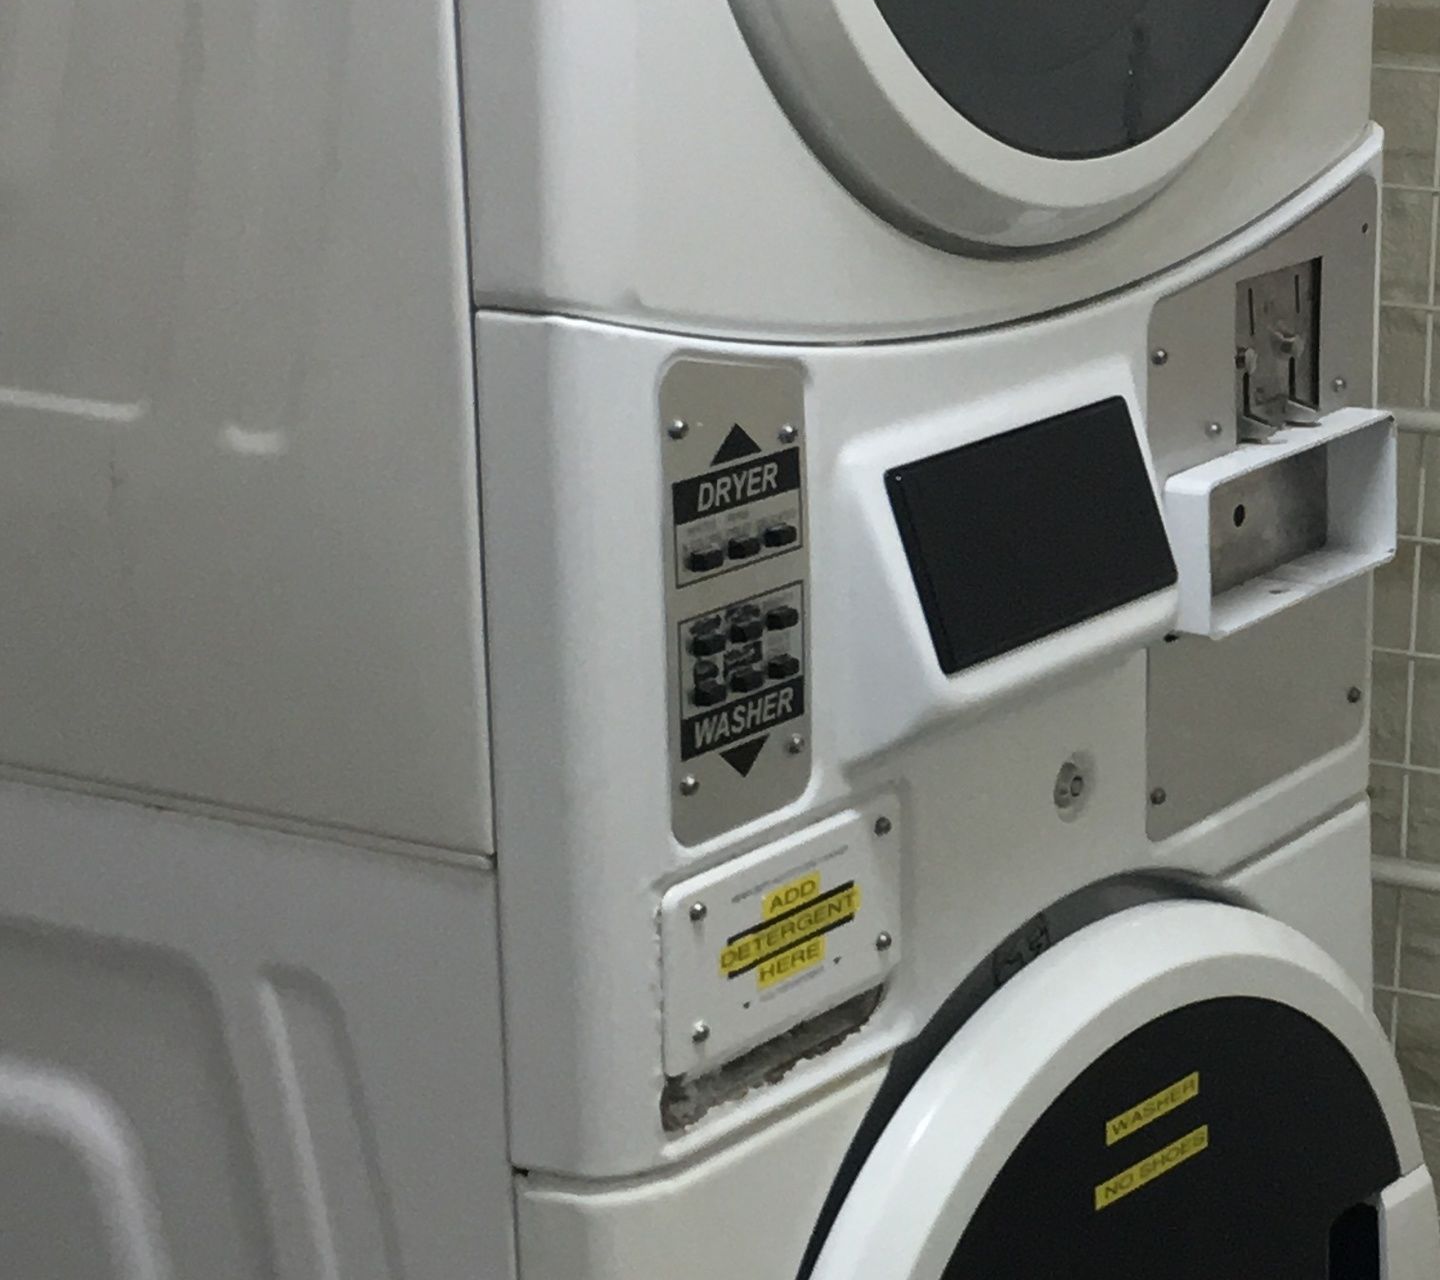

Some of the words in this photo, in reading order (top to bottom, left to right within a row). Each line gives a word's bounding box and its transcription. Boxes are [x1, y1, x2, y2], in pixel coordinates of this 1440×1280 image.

[697, 461, 779, 513] DRYER
[693, 686, 793, 750] WASHER
[768, 879, 817, 914] ADD
[720, 891, 858, 970] DETERGENT
[759, 941, 821, 983] HERE
[1111, 1078, 1196, 1136] WASHER
[1104, 1173, 1134, 1199] NO
[1138, 1131, 1206, 1180] SHOES
